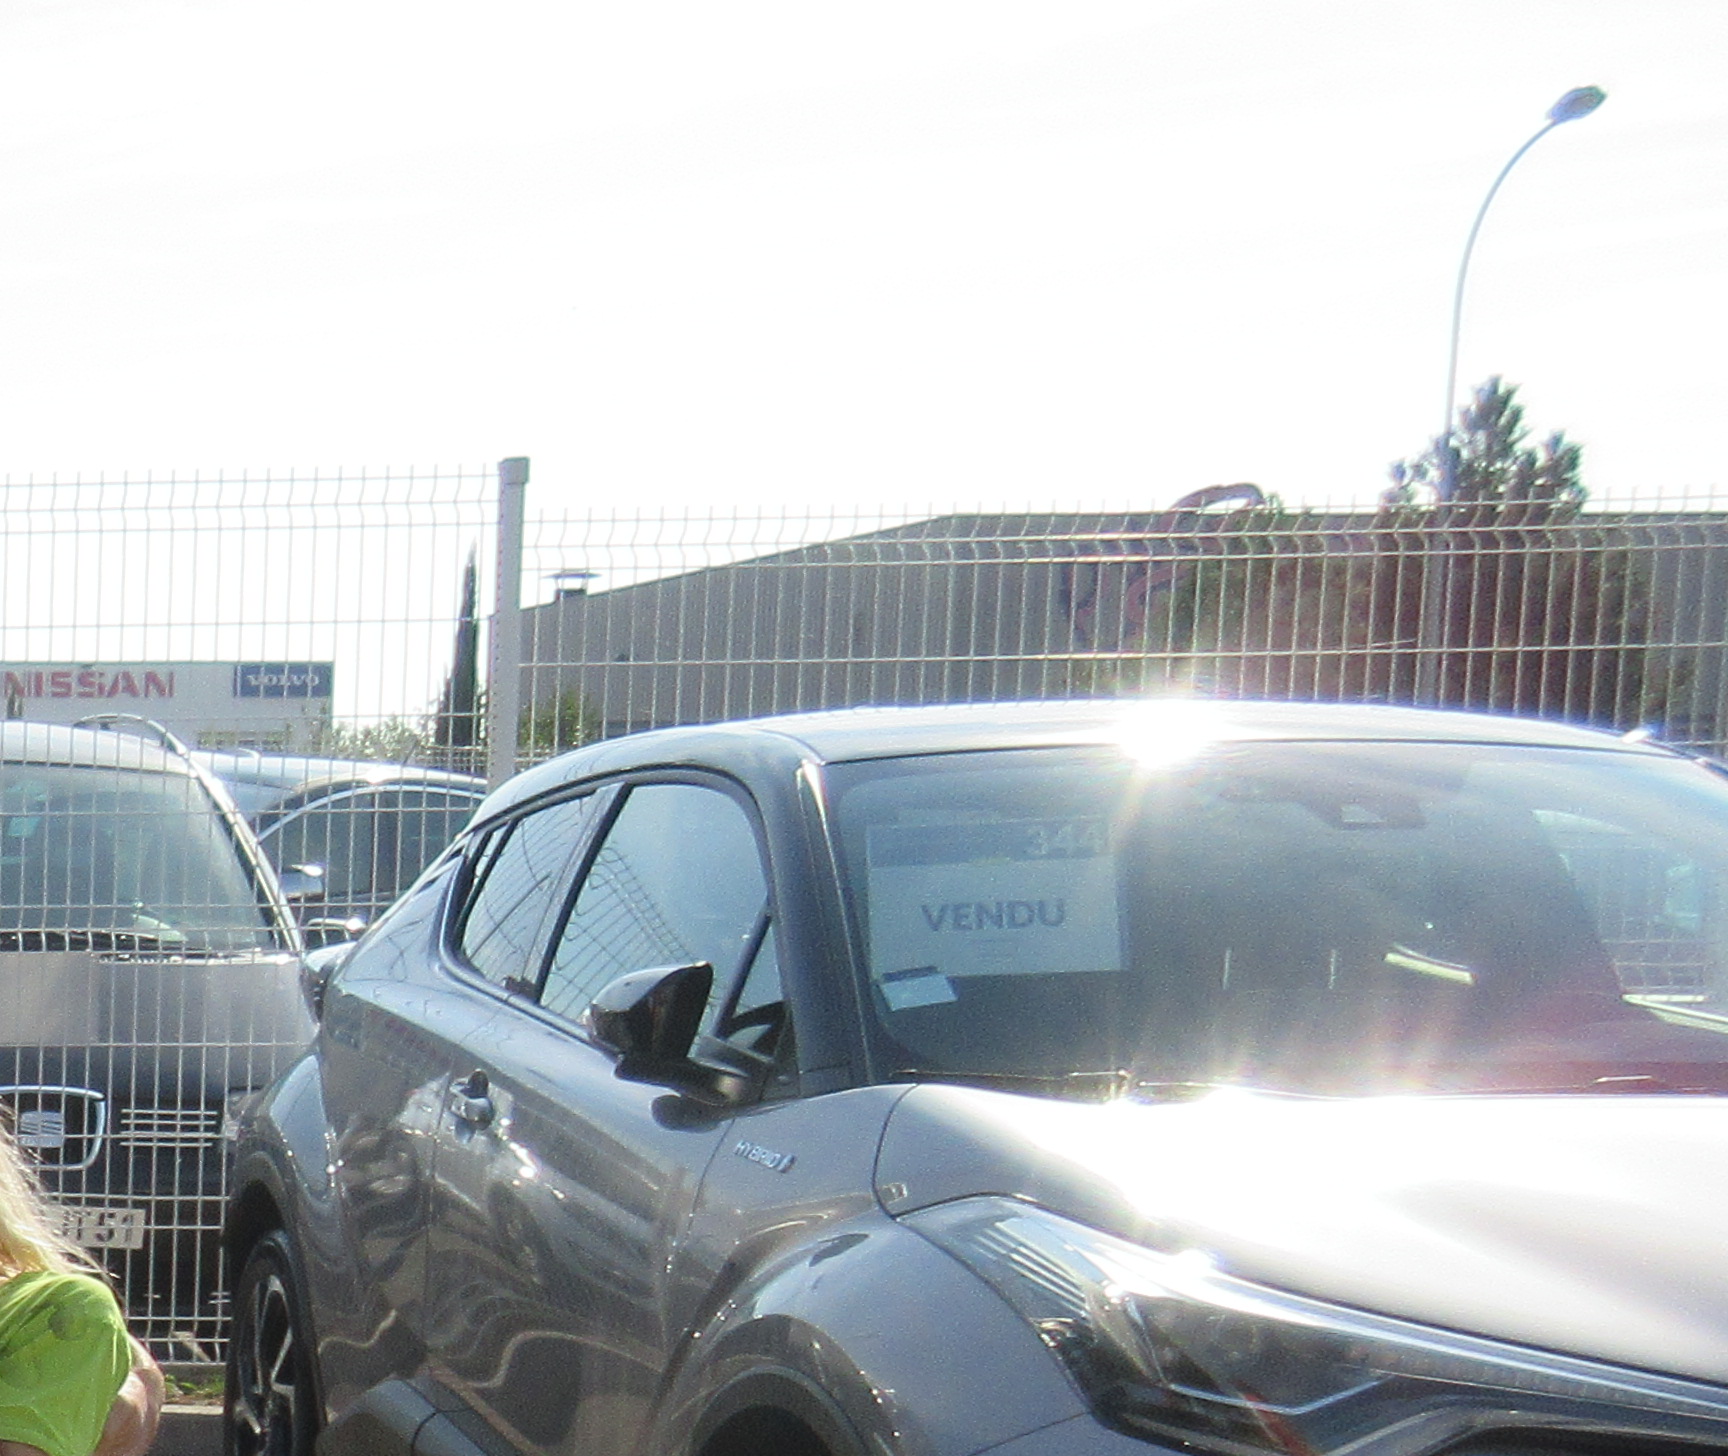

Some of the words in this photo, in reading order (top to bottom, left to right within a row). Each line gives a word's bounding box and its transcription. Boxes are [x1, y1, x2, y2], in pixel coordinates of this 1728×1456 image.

[3, 670, 176, 698] NISSAN
[246, 671, 319, 688] VOLVO
[1026, 822, 1104, 856] 344
[921, 898, 1065, 931] VENDU
